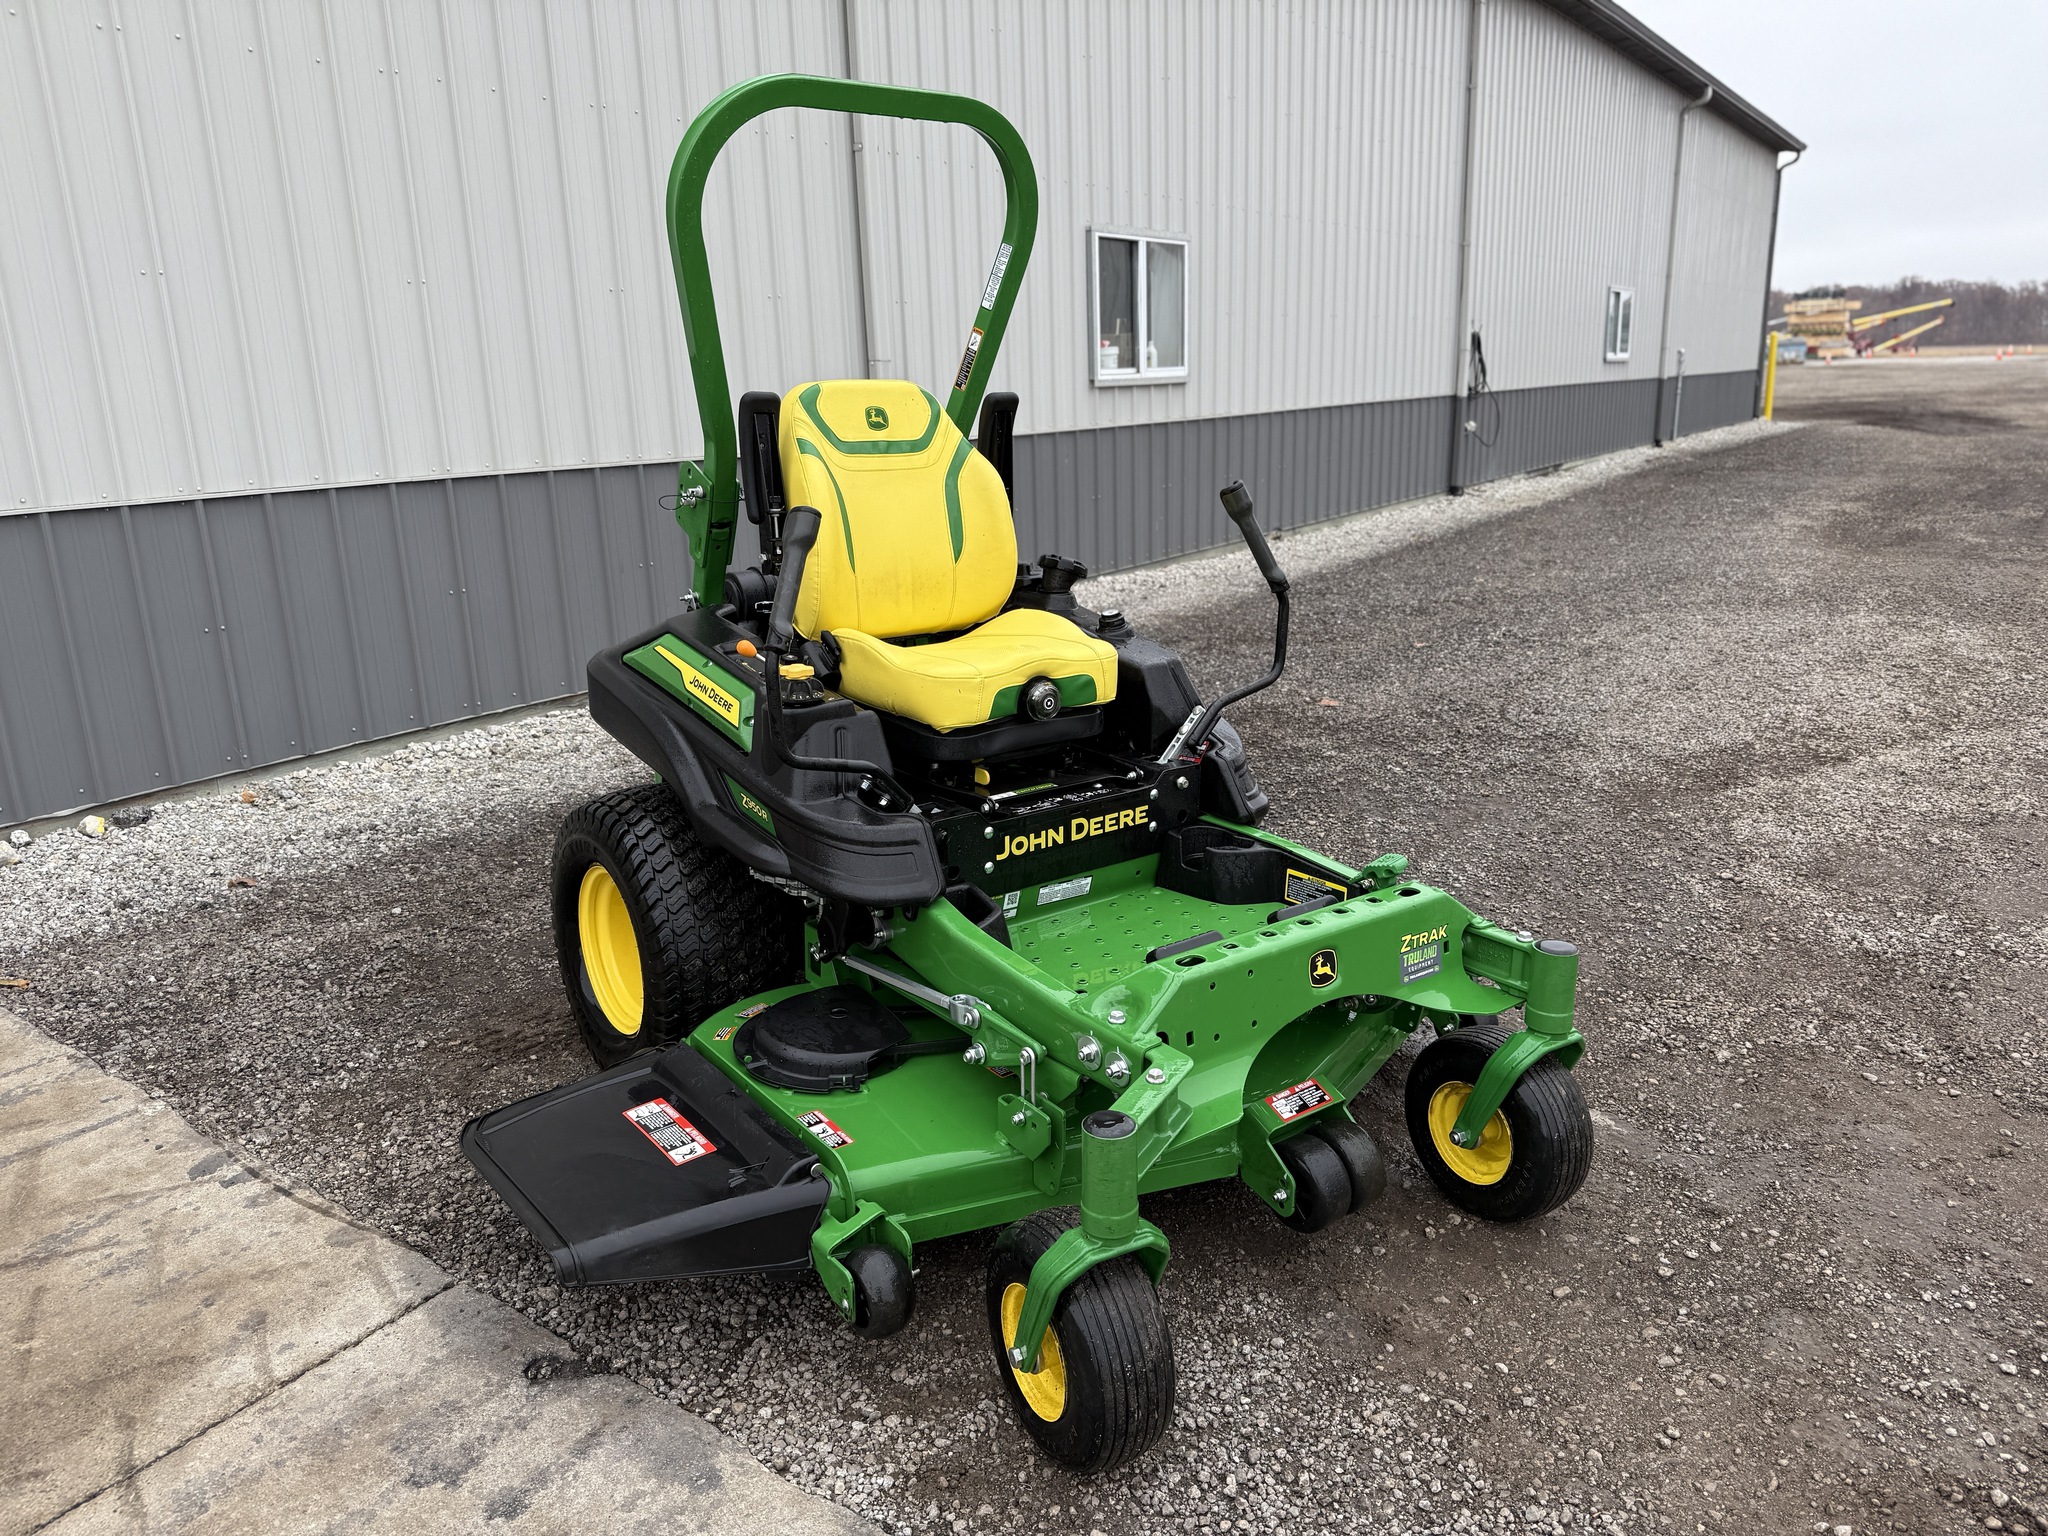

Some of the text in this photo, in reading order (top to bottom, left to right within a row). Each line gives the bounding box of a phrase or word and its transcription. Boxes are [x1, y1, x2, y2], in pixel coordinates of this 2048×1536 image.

[689, 675, 734, 713] JOHN DEERE
[996, 805, 1149, 861] JOHN DEERE
[1400, 924, 1448, 953] ZTRAK
[1403, 944, 1437, 968] TRULAND
